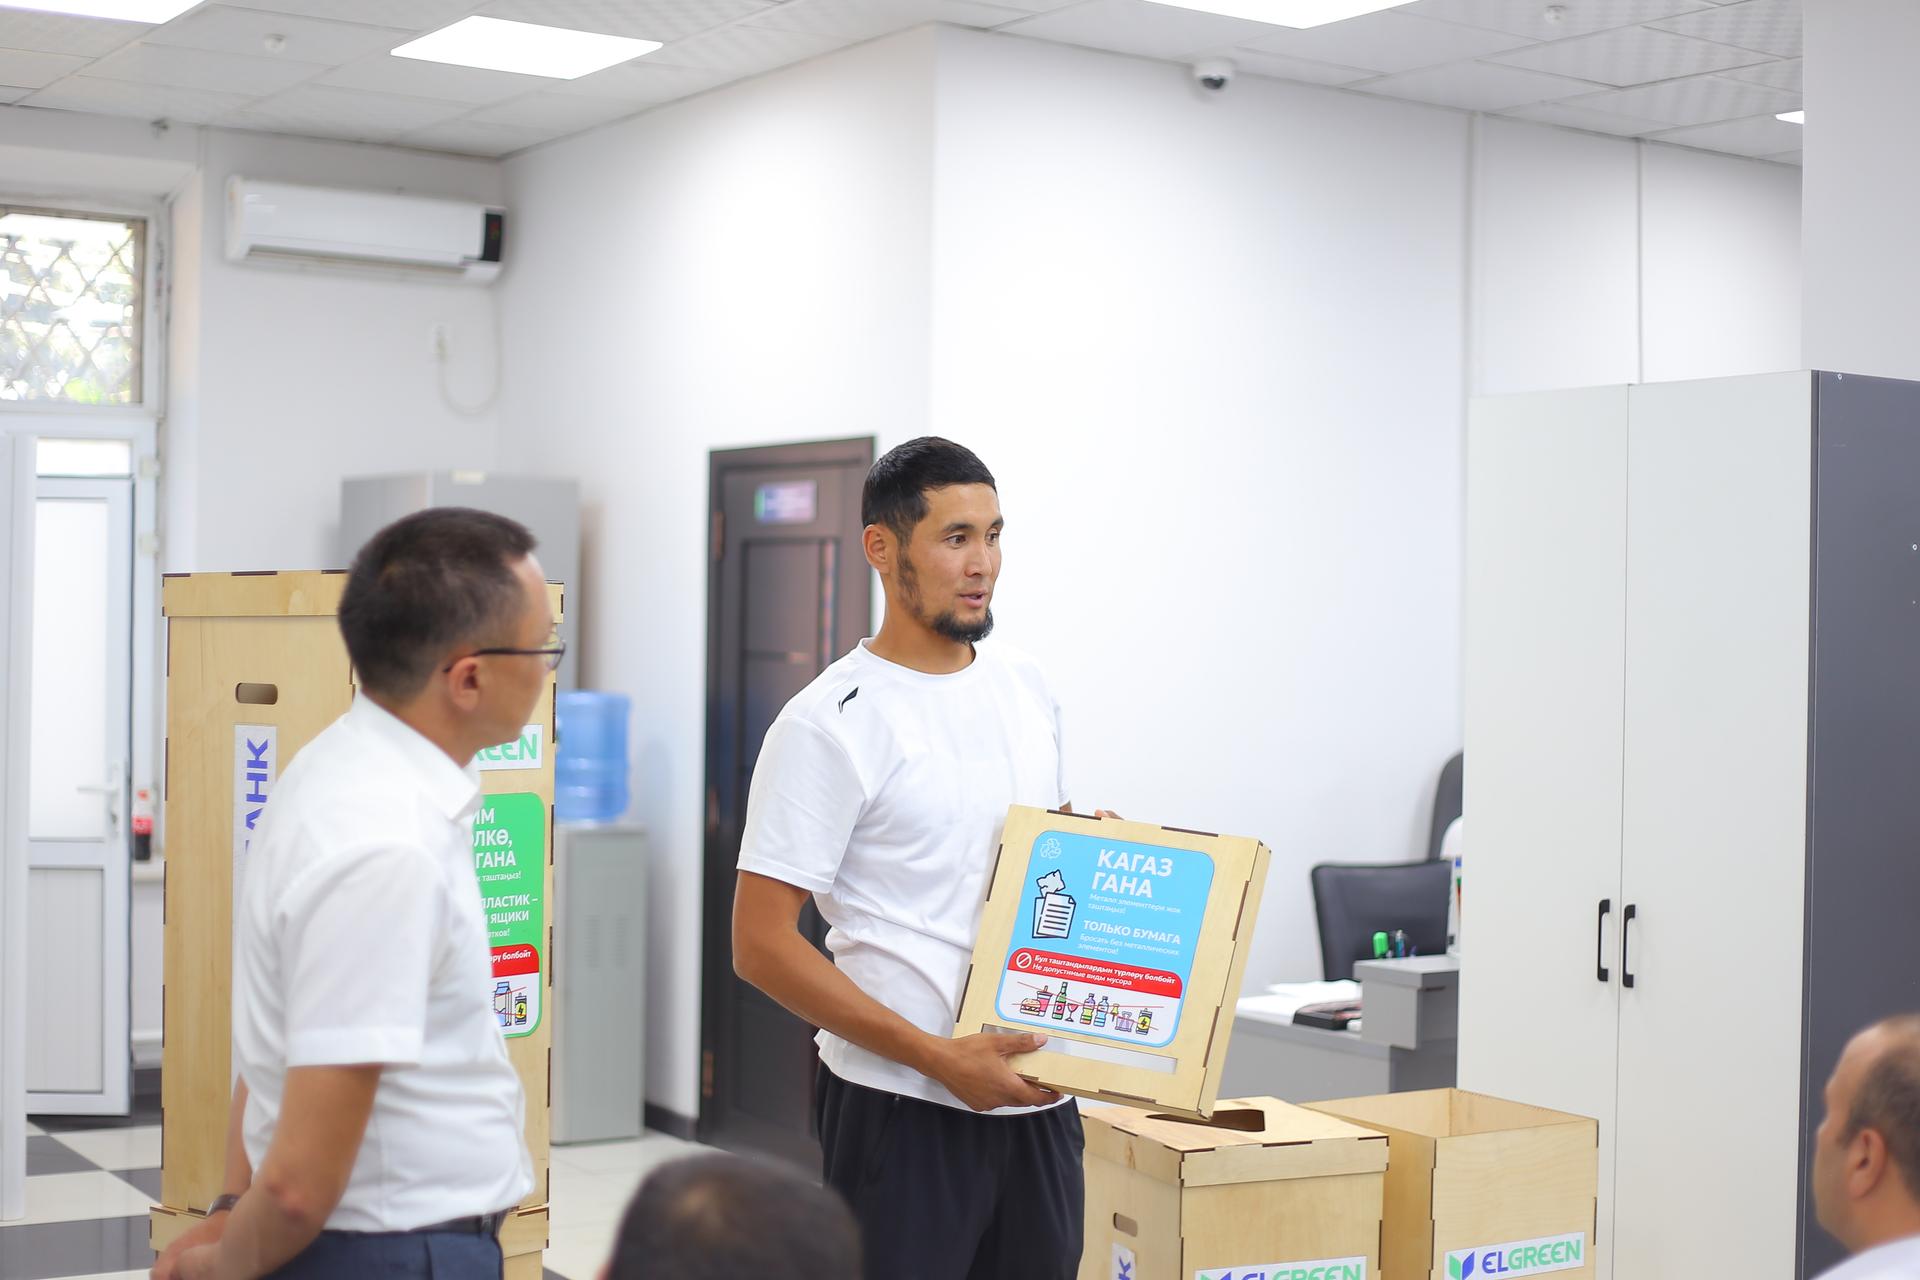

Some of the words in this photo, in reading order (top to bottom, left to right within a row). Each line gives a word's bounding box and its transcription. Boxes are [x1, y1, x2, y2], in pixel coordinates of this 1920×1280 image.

[476, 733, 538, 761] EEN
[245, 737, 269, 842] АНК
[473, 829, 513, 848] ЛКӨ,
[475, 850, 517, 869] ГАНА
[1096, 848, 1174, 878] КАГАЗ
[1091, 871, 1153, 898] ГАНА
[490, 910, 530, 925] ЯЩИКИ
[1080, 933, 1109, 945] Бросать
[1110, 938, 1123, 947] без
[1124, 942, 1180, 955] металлических
[1083, 919, 1131, 937] ТОЛЬКО
[1132, 928, 1182, 945] БУМАГА
[502, 949, 532, 960] болбойт
[1032, 963, 1043, 971] Не
[1042, 966, 1086, 978] допустимые
[1086, 973, 1106, 982] виды
[1106, 977, 1132, 986] мусора
[1034, 954, 1048, 963] Бул
[1049, 958, 1114, 974] таштандылардын
[1144, 973, 1176, 984] болбойт
[1481, 1239, 1582, 1274] ELGREEN
